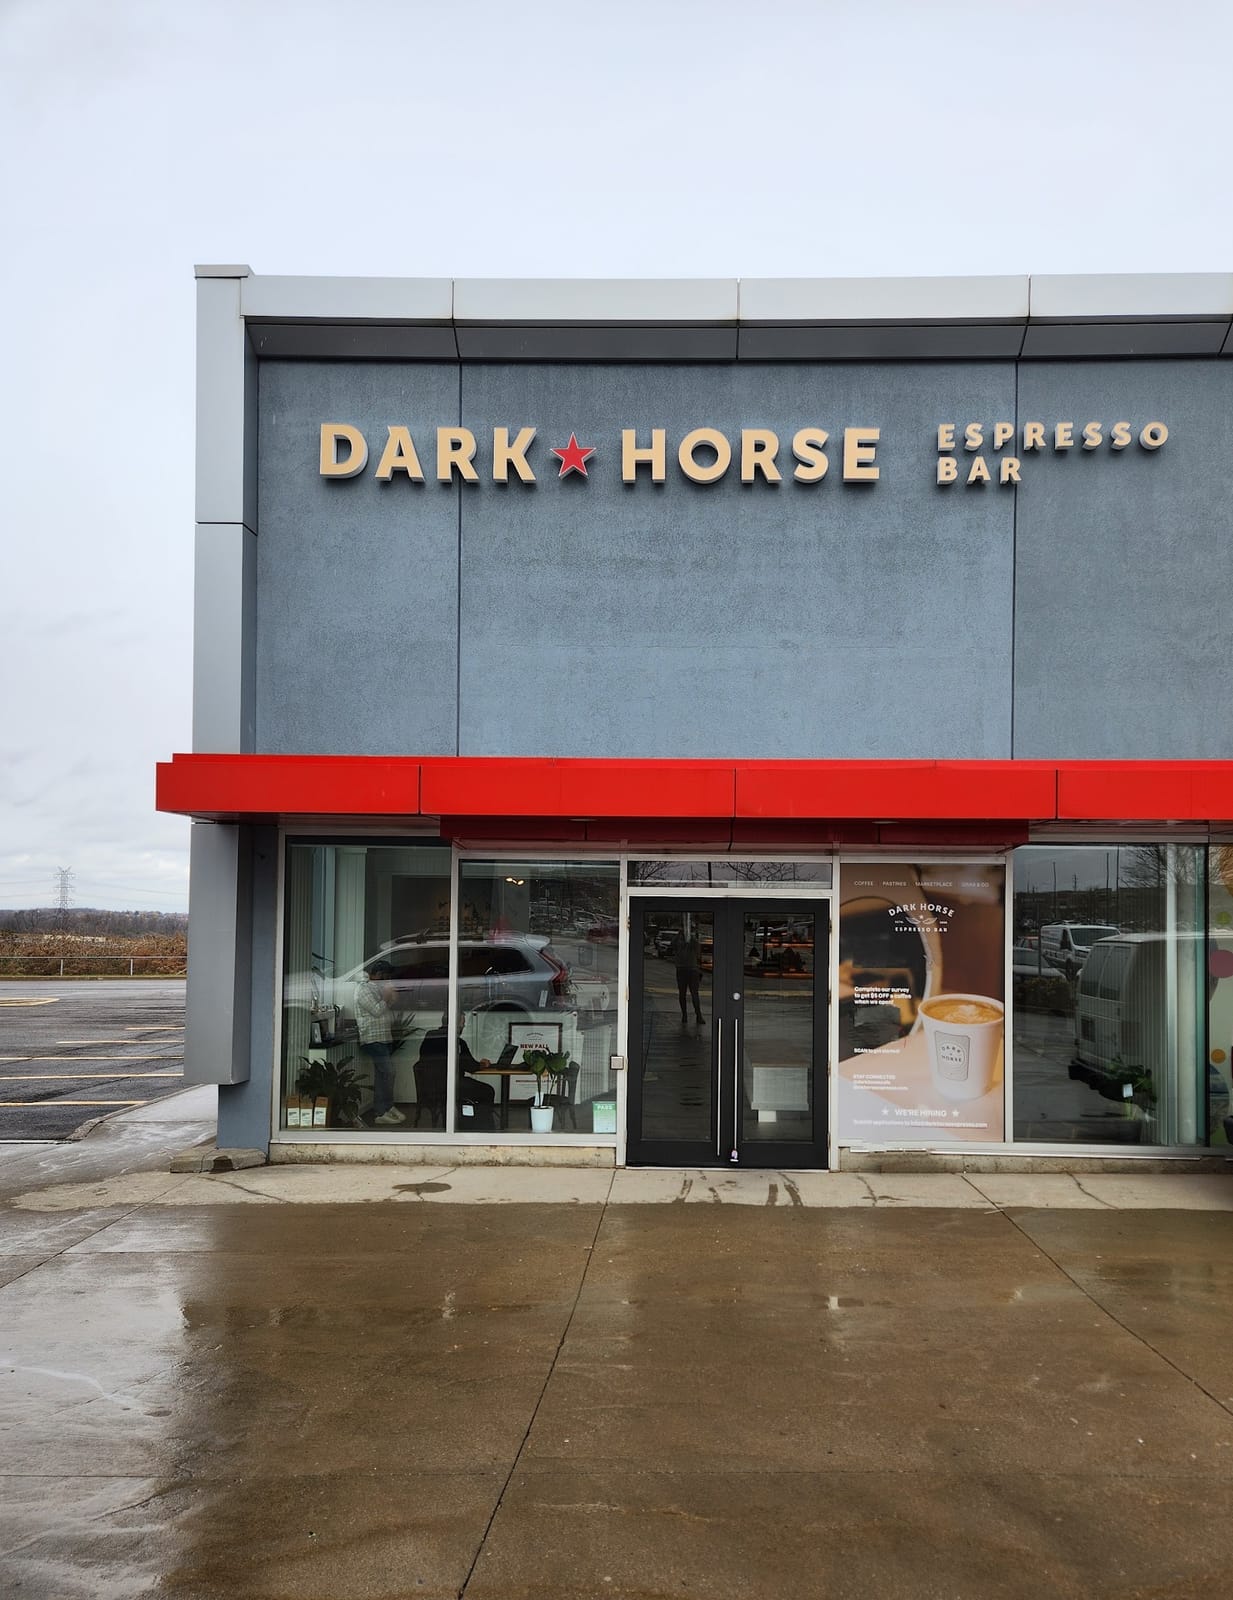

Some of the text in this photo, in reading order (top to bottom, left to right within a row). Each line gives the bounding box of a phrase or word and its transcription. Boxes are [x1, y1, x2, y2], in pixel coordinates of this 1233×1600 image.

[937, 421, 1169, 451] ESPRESSO
[320, 423, 881, 485] DARK HORSE
[937, 456, 1022, 485] BAR
[888, 904, 955, 917] DARK HORSE
